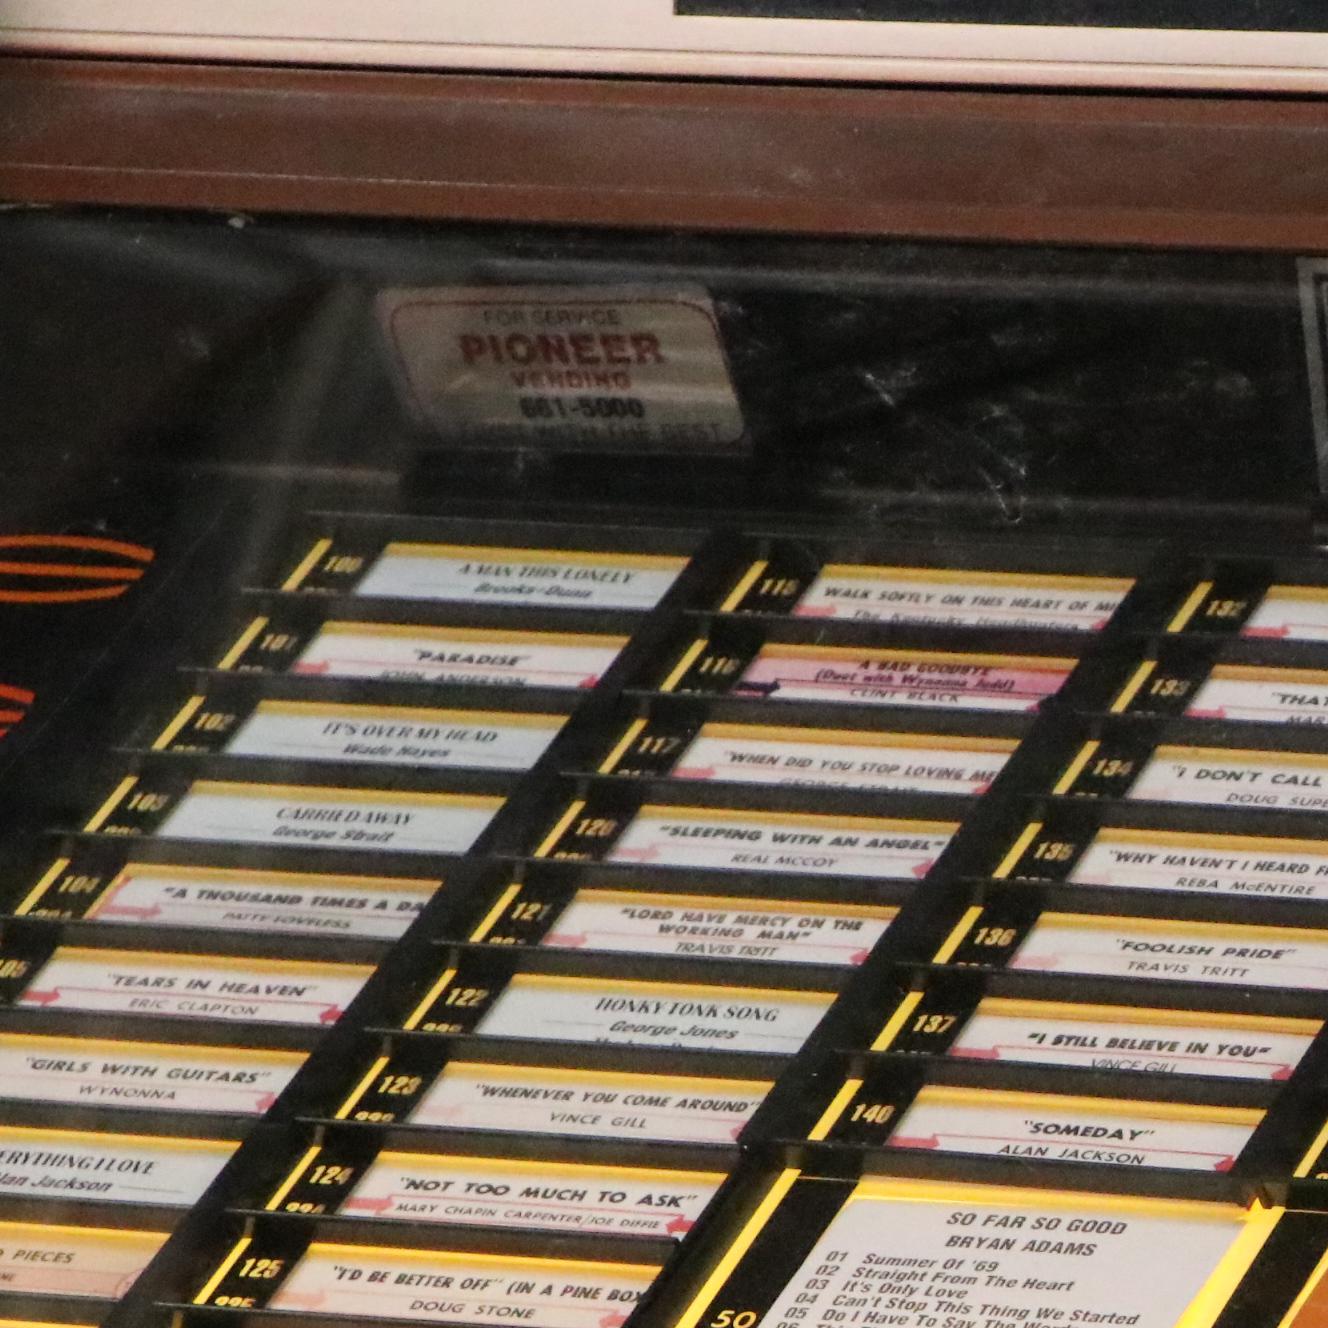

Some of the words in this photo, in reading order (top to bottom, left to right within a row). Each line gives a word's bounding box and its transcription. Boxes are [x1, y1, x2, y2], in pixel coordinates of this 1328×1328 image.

[459, 334, 665, 365] PIONEER
[511, 372, 631, 389] VENDING
[660, 824, 763, 842] "SLEEPING
[772, 830, 823, 846] WITH
[830, 834, 856, 847] AN
[864, 836, 946, 852] ANGEL"
[1117, 939, 1213, 957] "FOOLISH
[1222, 946, 1298, 961] PRIDE"
[1127, 961, 1192, 975] TRAVIS
[1201, 963, 1251, 978] TRITT
[108, 971, 177, 991] "TEARS
[186, 979, 210, 993] IN
[220, 979, 317, 1000] HEAVEN"
[129, 998, 167, 1012] ERIC
[178, 1000, 259, 1017] CLAPTON
[26, 1057, 90, 1076] "GIRLS
[101, 1063, 159, 1079] WITH
[167, 1065, 270, 1086] GUITARS"
[79, 1085, 176, 1102] WYNONNA
[852, 1104, 893, 1124] 140
[1025, 1119, 1154, 1143] "SOMEDAY"
[999, 1143, 1050, 1160] ALAN
[1061, 1147, 1146, 1165] JACKSON
[310, 1164, 347, 1185] 124
[402, 1176, 455, 1197] "NOT
[465, 1182, 509, 1199] TOO
[520, 1185, 588, 1203] MUCH
[597, 1190, 628, 1204] TO
[638, 1191, 697, 1210] ASK"
[947, 1211, 975, 1226] SO
[982, 1213, 1025, 1230] FAR
[1032, 1217, 1061, 1232] SO
[1067, 1218, 1128, 1235] GOOD
[945, 1234, 1016, 1253] BRYAN
[1021, 1240, 1098, 1258] ADAMS
[241, 1258, 281, 1280] 125
[410, 1298, 466, 1316] DOUG
[476, 1304, 535, 1320] STONE
